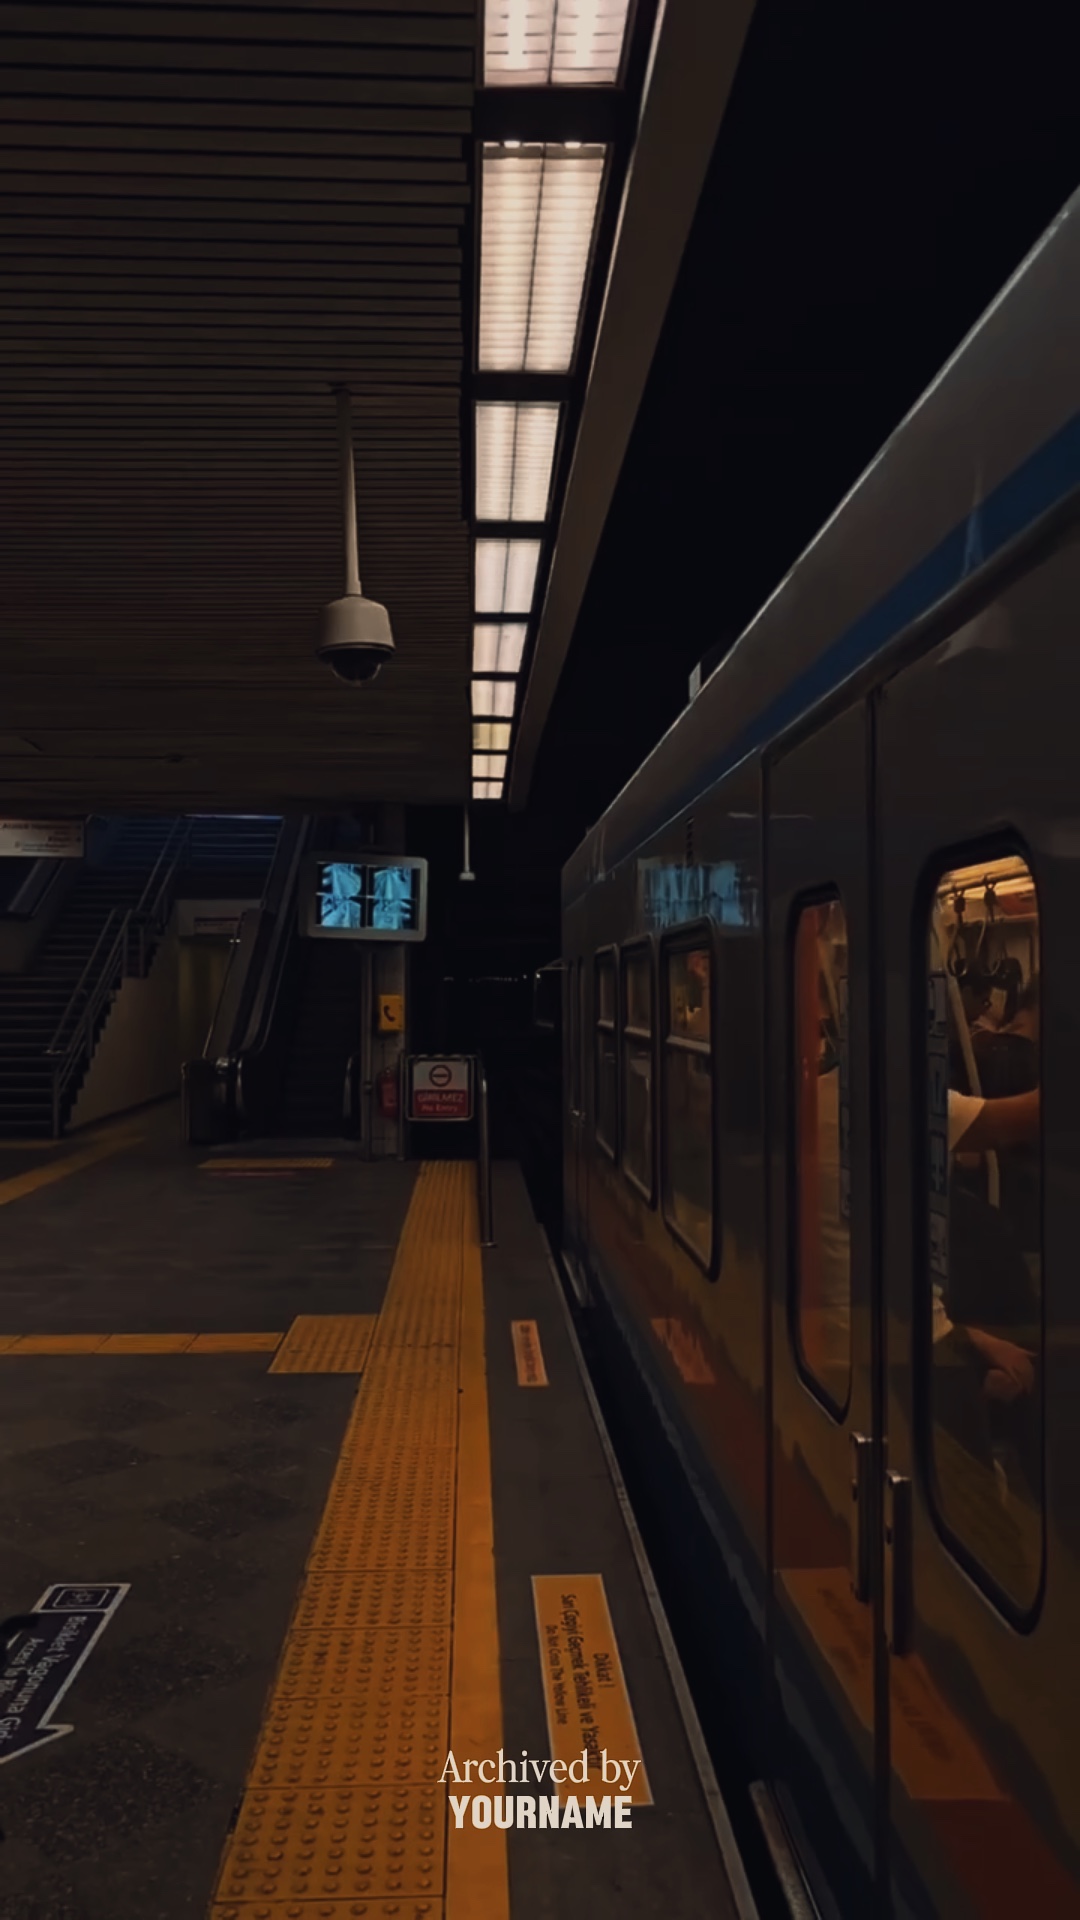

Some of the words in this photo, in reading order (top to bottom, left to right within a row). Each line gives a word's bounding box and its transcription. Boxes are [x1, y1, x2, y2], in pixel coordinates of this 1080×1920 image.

[46, 1615, 88, 1653] Bisiklet
[10, 1637, 45, 1666] Access
[564, 1636, 589, 1669] Geçmek
[551, 1667, 564, 1680] The
[593, 1653, 613, 1682] Dikkat
[6, 1653, 71, 1714] Vagonuna
[553, 1682, 567, 1706] Yellow
[573, 1670, 597, 1709] Tehlikeli
[555, 1708, 569, 1725] Line
[580, 1711, 594, 1724] ve
